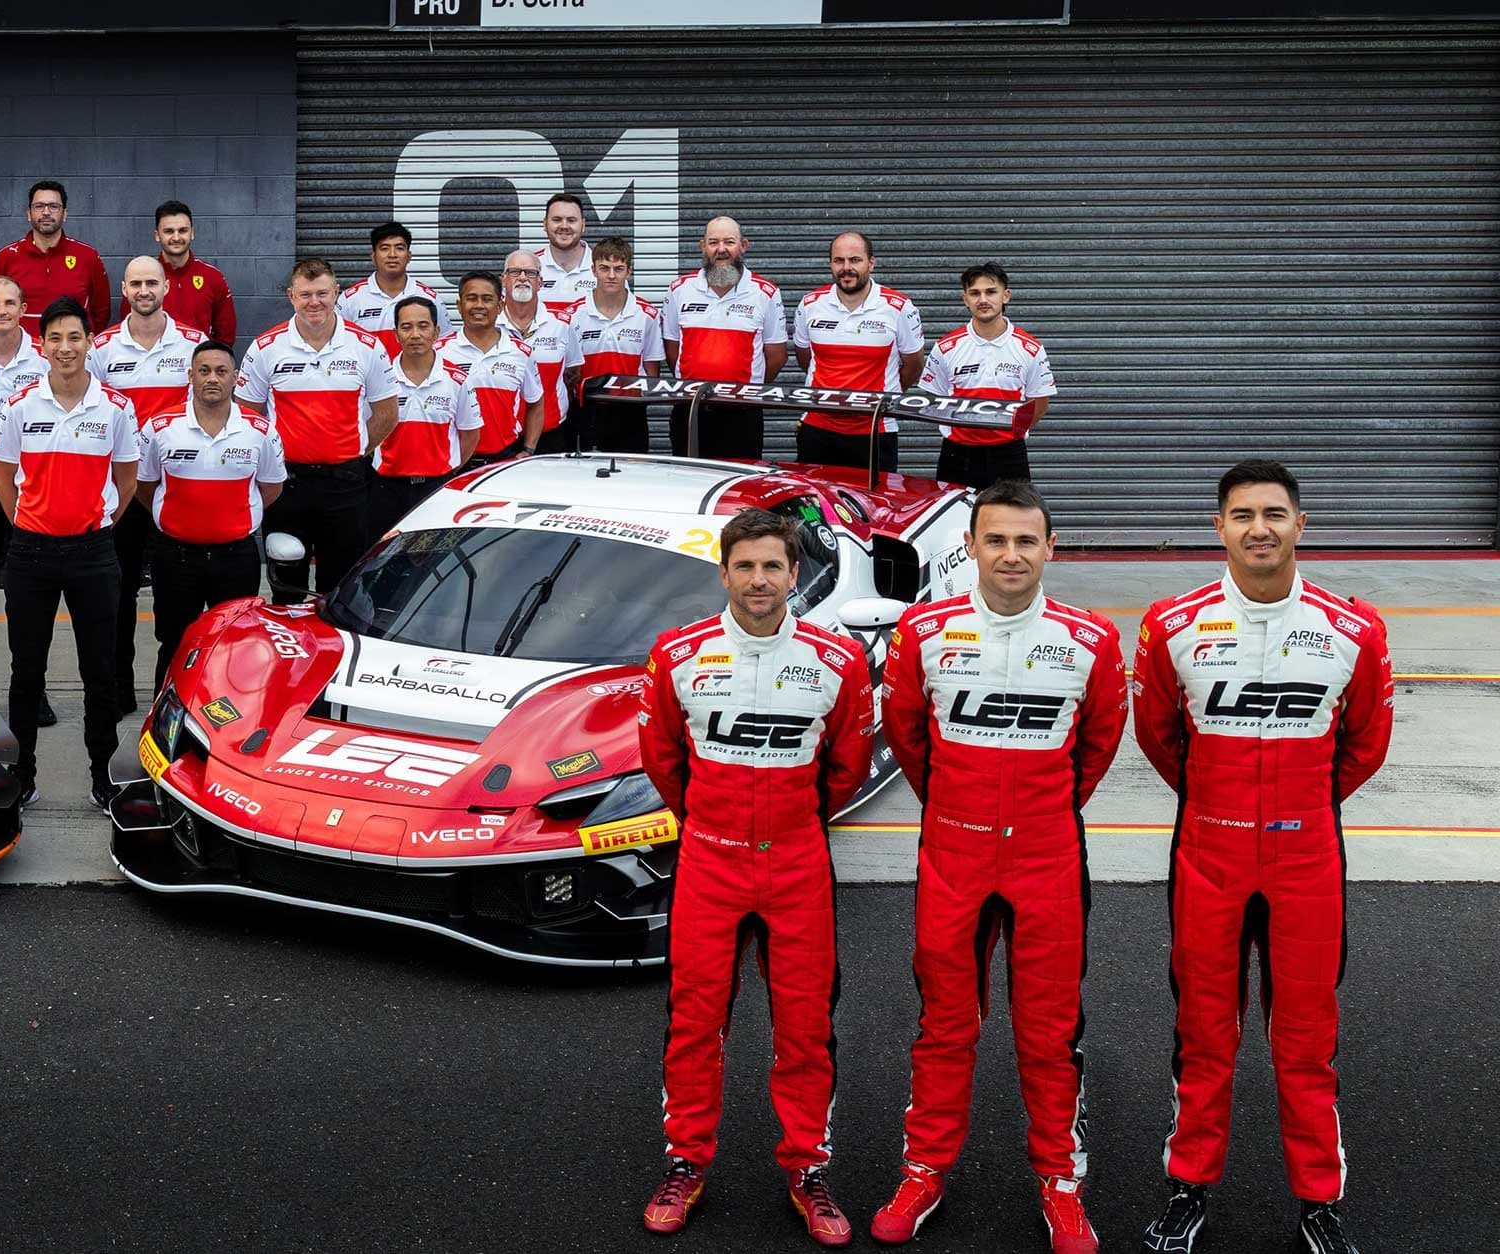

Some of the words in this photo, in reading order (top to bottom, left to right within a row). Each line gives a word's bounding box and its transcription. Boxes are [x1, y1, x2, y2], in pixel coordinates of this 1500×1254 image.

[393, 128, 680, 325] 01
[358, 308, 383, 318] LEE
[680, 303, 710, 312] LEE
[728, 303, 755, 312] ARISE
[810, 319, 839, 330] LEE
[859, 319, 887, 328] ARISE
[107, 362, 137, 373] LEE
[159, 357, 186, 365] ARISE
[273, 362, 306, 374] LEE
[954, 364, 980, 375] LEE
[741, 383, 848, 402] EAST
[23, 422, 55, 433] LEE
[78, 421, 108, 430] ARISE
[167, 449, 199, 460] LEE
[224, 448, 253, 456] ARISE
[547, 512, 672, 537] INTERCONTINENTAL
[539, 519, 559, 528] GT
[564, 521, 669, 545] CHALLENGE
[916, 620, 939, 636] OMP
[1165, 614, 1189, 632] OMP
[1336, 617, 1361, 634] OMP
[259, 616, 311, 659] ARGT
[1076, 629, 1100, 645] OMP
[1287, 630, 1333, 645] ARISE
[669, 644, 692, 659] OMP
[1031, 644, 1077, 657] ARISE
[1283, 640, 1323, 649] RACING
[823, 650, 846, 666] OMP
[1027, 653, 1065, 663] RACING
[777, 673, 812, 684] RACING
[780, 665, 822, 679] ARISE
[946, 669, 980, 677] CHALLENGE
[358, 673, 507, 704] BARBAGALLO
[1204, 680, 1329, 719] LEE
[948, 689, 1067, 730] LEE
[705, 710, 815, 749] LEE
[1201, 719, 1231, 727] ANCE
[1266, 721, 1310, 729] EXOTICS
[945, 726, 973, 736] LANCE
[976, 730, 1004, 738] EAST
[1008, 732, 1051, 740] EXOTICS
[276, 728, 483, 788] LEE
[264, 766, 313, 778] LANCE
[318, 772, 360, 784] EAST
[363, 779, 432, 796] EXOTICS
[207, 782, 262, 816] IVECO
[963, 822, 993, 832] RIGON
[1221, 819, 1256, 828] EVANS
[411, 827, 495, 844] IVECO
[590, 818, 671, 850] PIRELLI
